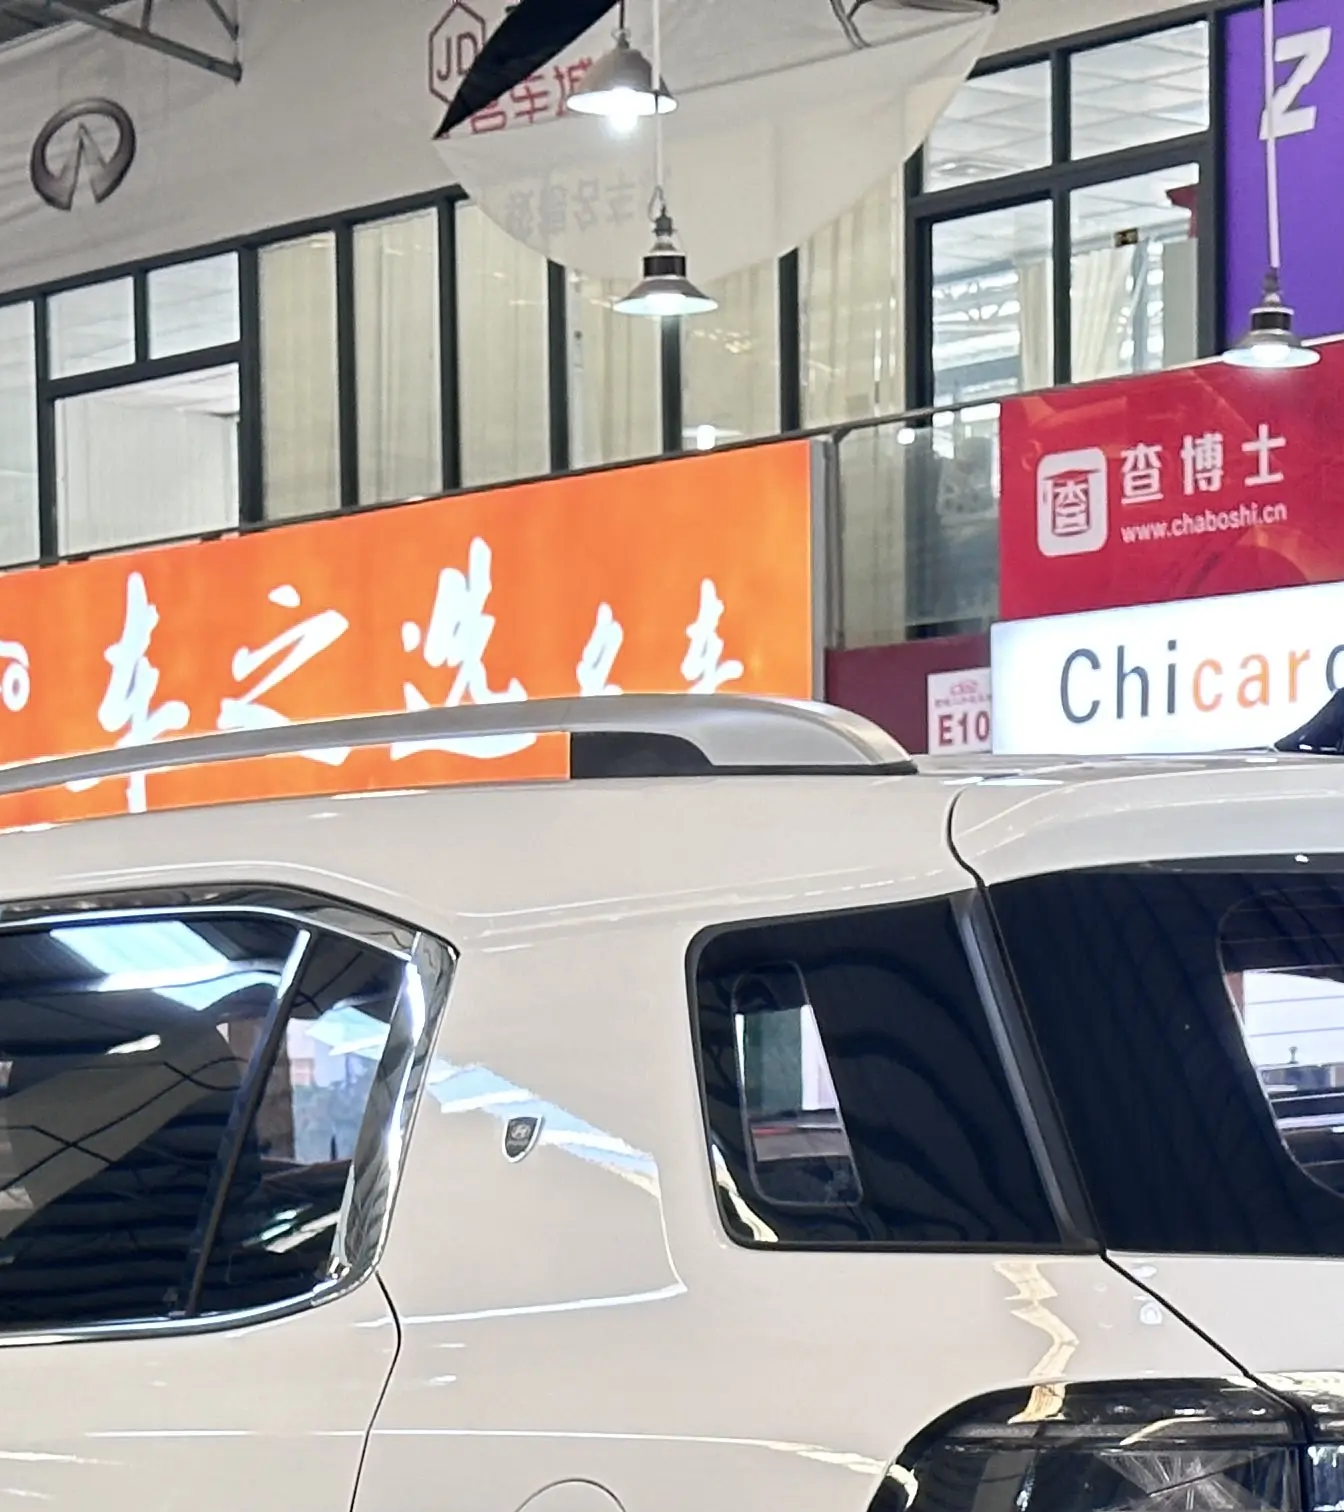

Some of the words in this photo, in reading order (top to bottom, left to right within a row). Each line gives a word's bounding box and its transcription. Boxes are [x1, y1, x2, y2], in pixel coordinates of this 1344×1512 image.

[1120, 423, 1287, 504] 查博士
[1120, 502, 1288, 543] www.chaboshi.cn
[939, 711, 991, 746] E10
